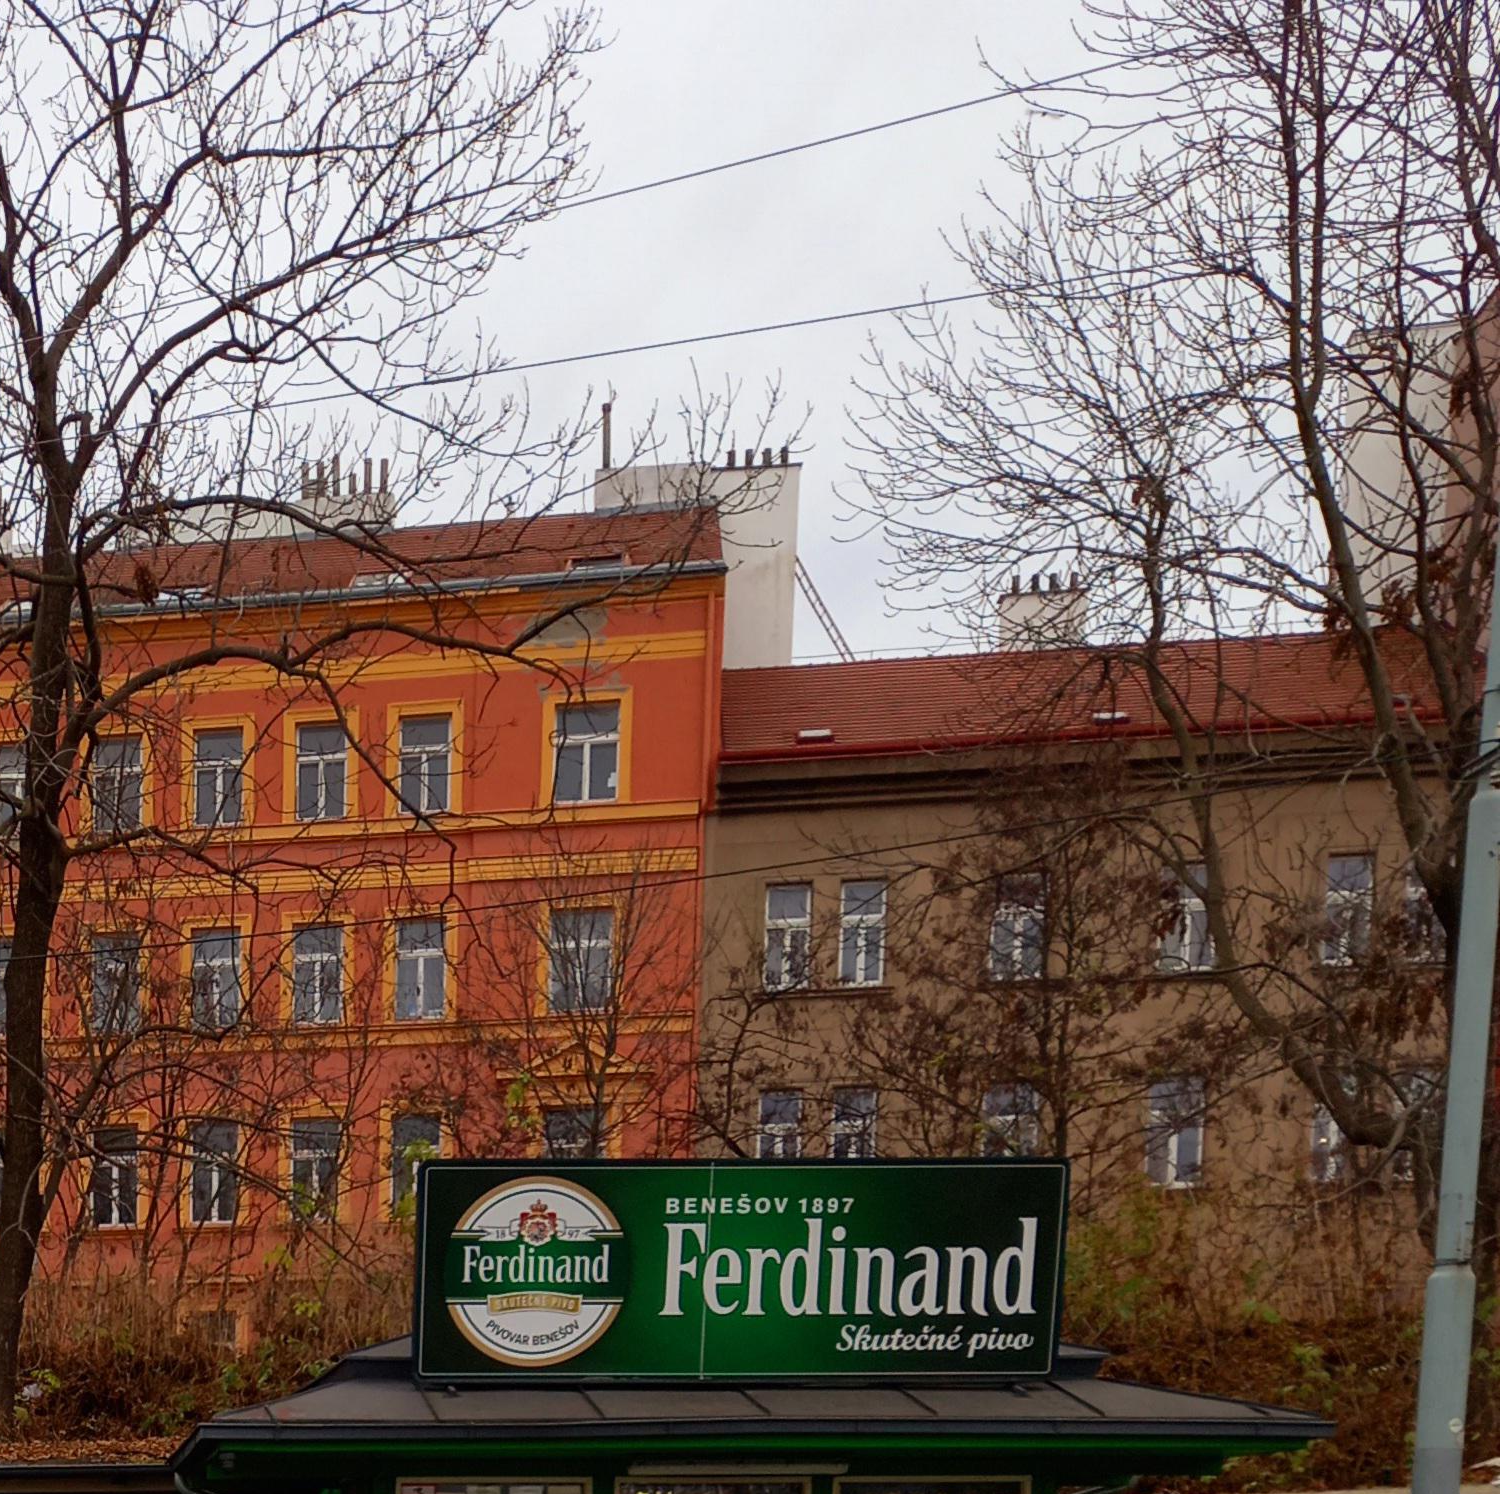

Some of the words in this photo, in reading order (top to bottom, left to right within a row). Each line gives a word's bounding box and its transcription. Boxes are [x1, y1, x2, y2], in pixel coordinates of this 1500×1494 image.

[665, 1193, 789, 1214] BENEŠOV
[798, 1198, 855, 1214] 1897
[495, 1229, 506, 1239] 18
[567, 1229, 581, 1239] 97
[461, 1244, 610, 1283] Ferdinand
[657, 1217, 1038, 1317] Ferdinand
[486, 1319, 529, 1345] PIVOVAR
[532, 1321, 580, 1346] BENEŠOV
[835, 1323, 963, 1353] Skutečné
[966, 1326, 1034, 1358] pivo
